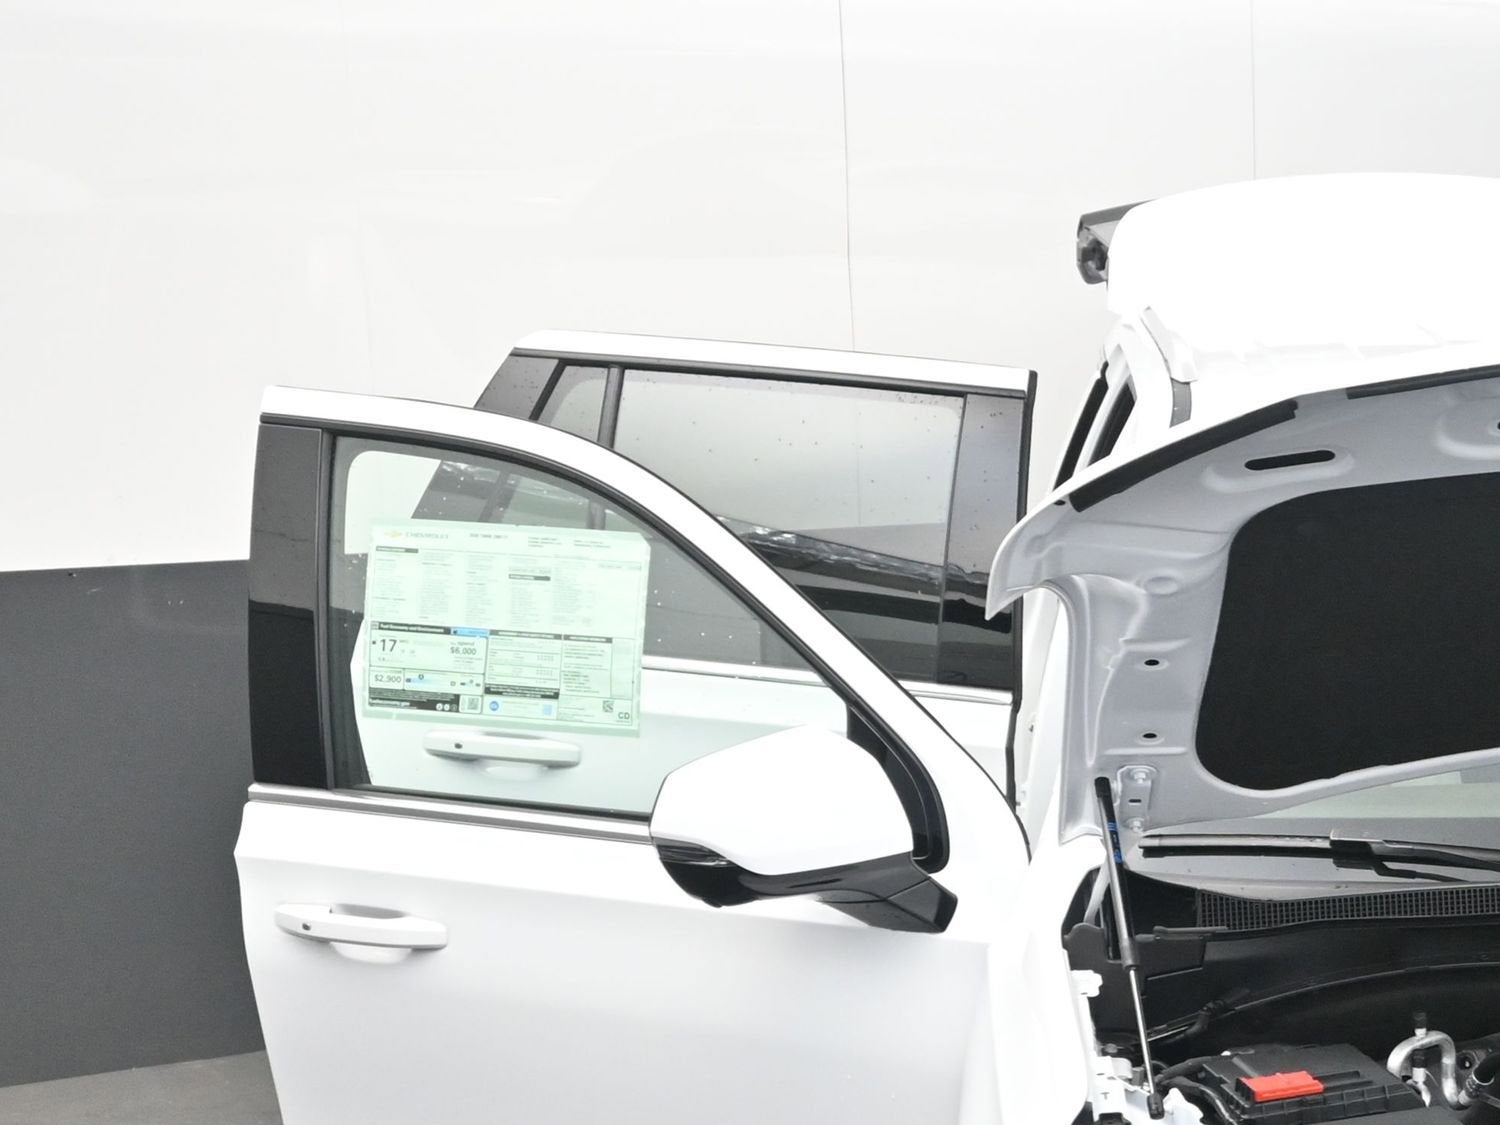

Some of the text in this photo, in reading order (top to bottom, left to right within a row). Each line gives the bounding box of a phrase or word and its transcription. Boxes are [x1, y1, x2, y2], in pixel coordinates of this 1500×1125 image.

[380, 639, 397, 652] 17
[450, 646, 477, 656] $6,000
[374, 674, 402, 684] $2,900
